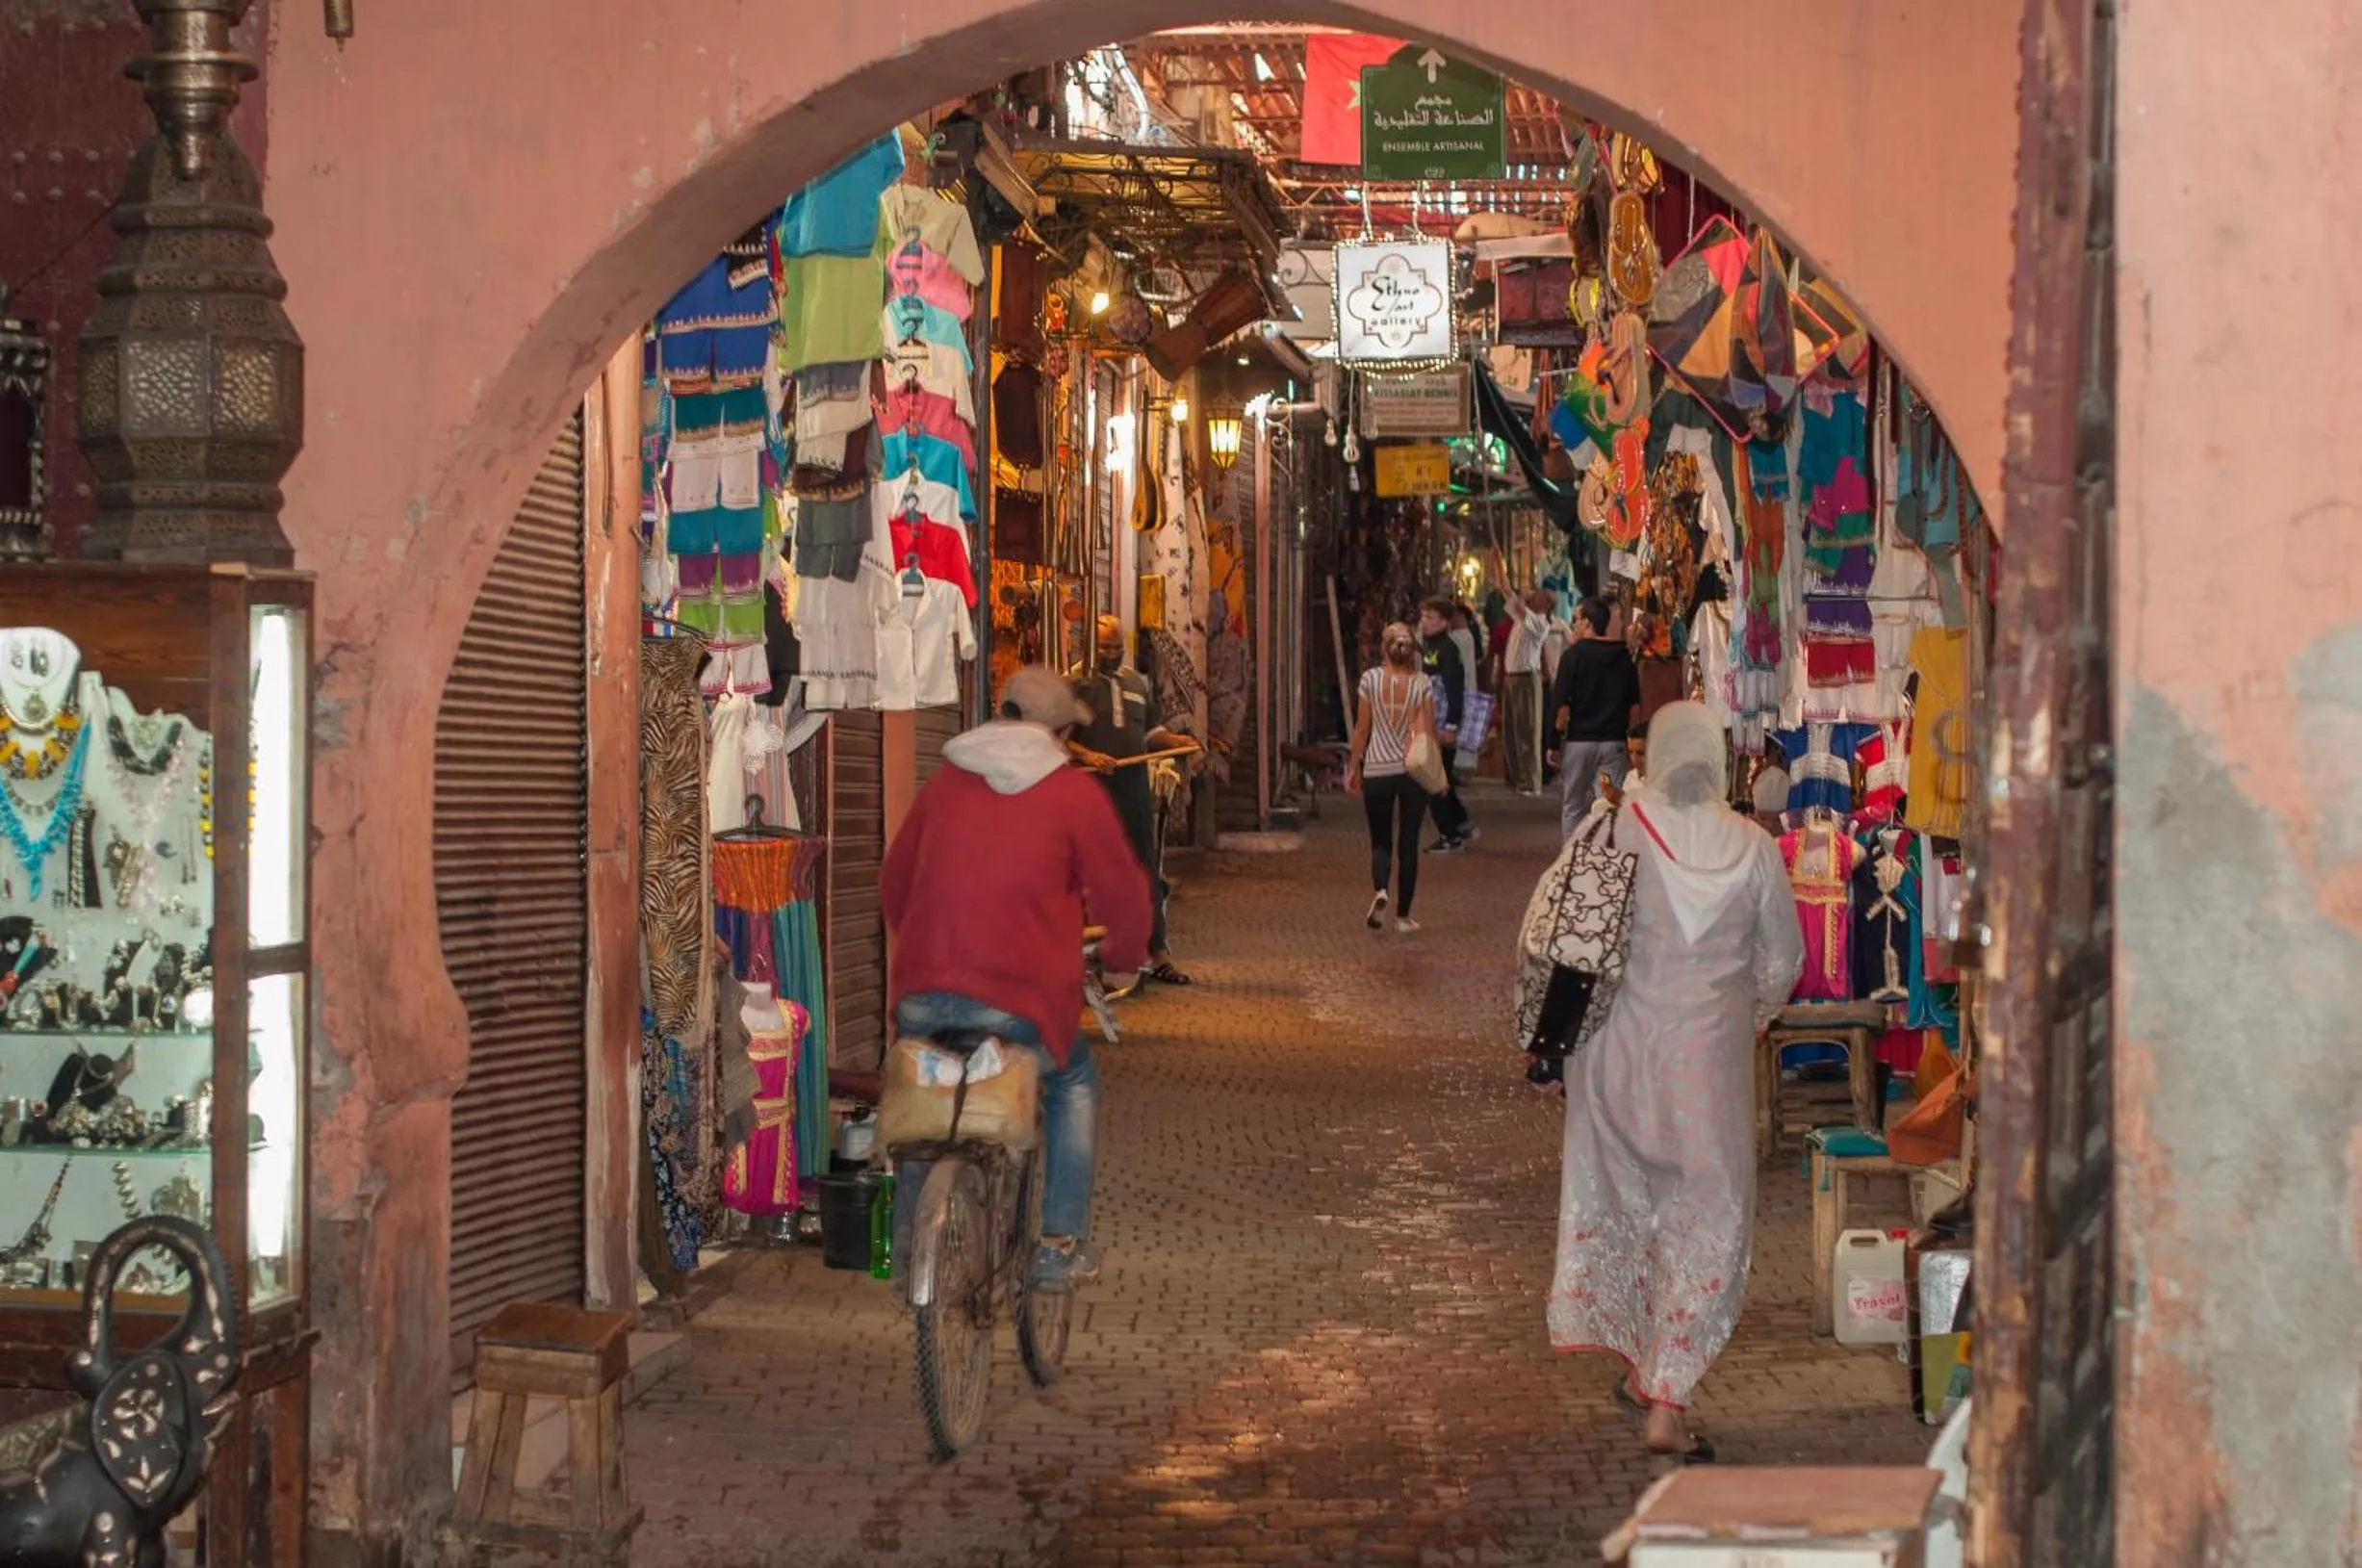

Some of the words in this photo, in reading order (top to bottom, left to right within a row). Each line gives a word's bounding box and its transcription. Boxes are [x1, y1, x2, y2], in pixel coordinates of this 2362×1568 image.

[1374, 108, 1430, 130] التقليدية
[1434, 108, 1494, 126] الصناعة
[1382, 141, 1430, 152] ENSEMBLE
[1432, 141, 1485, 152] ARTISANAL
